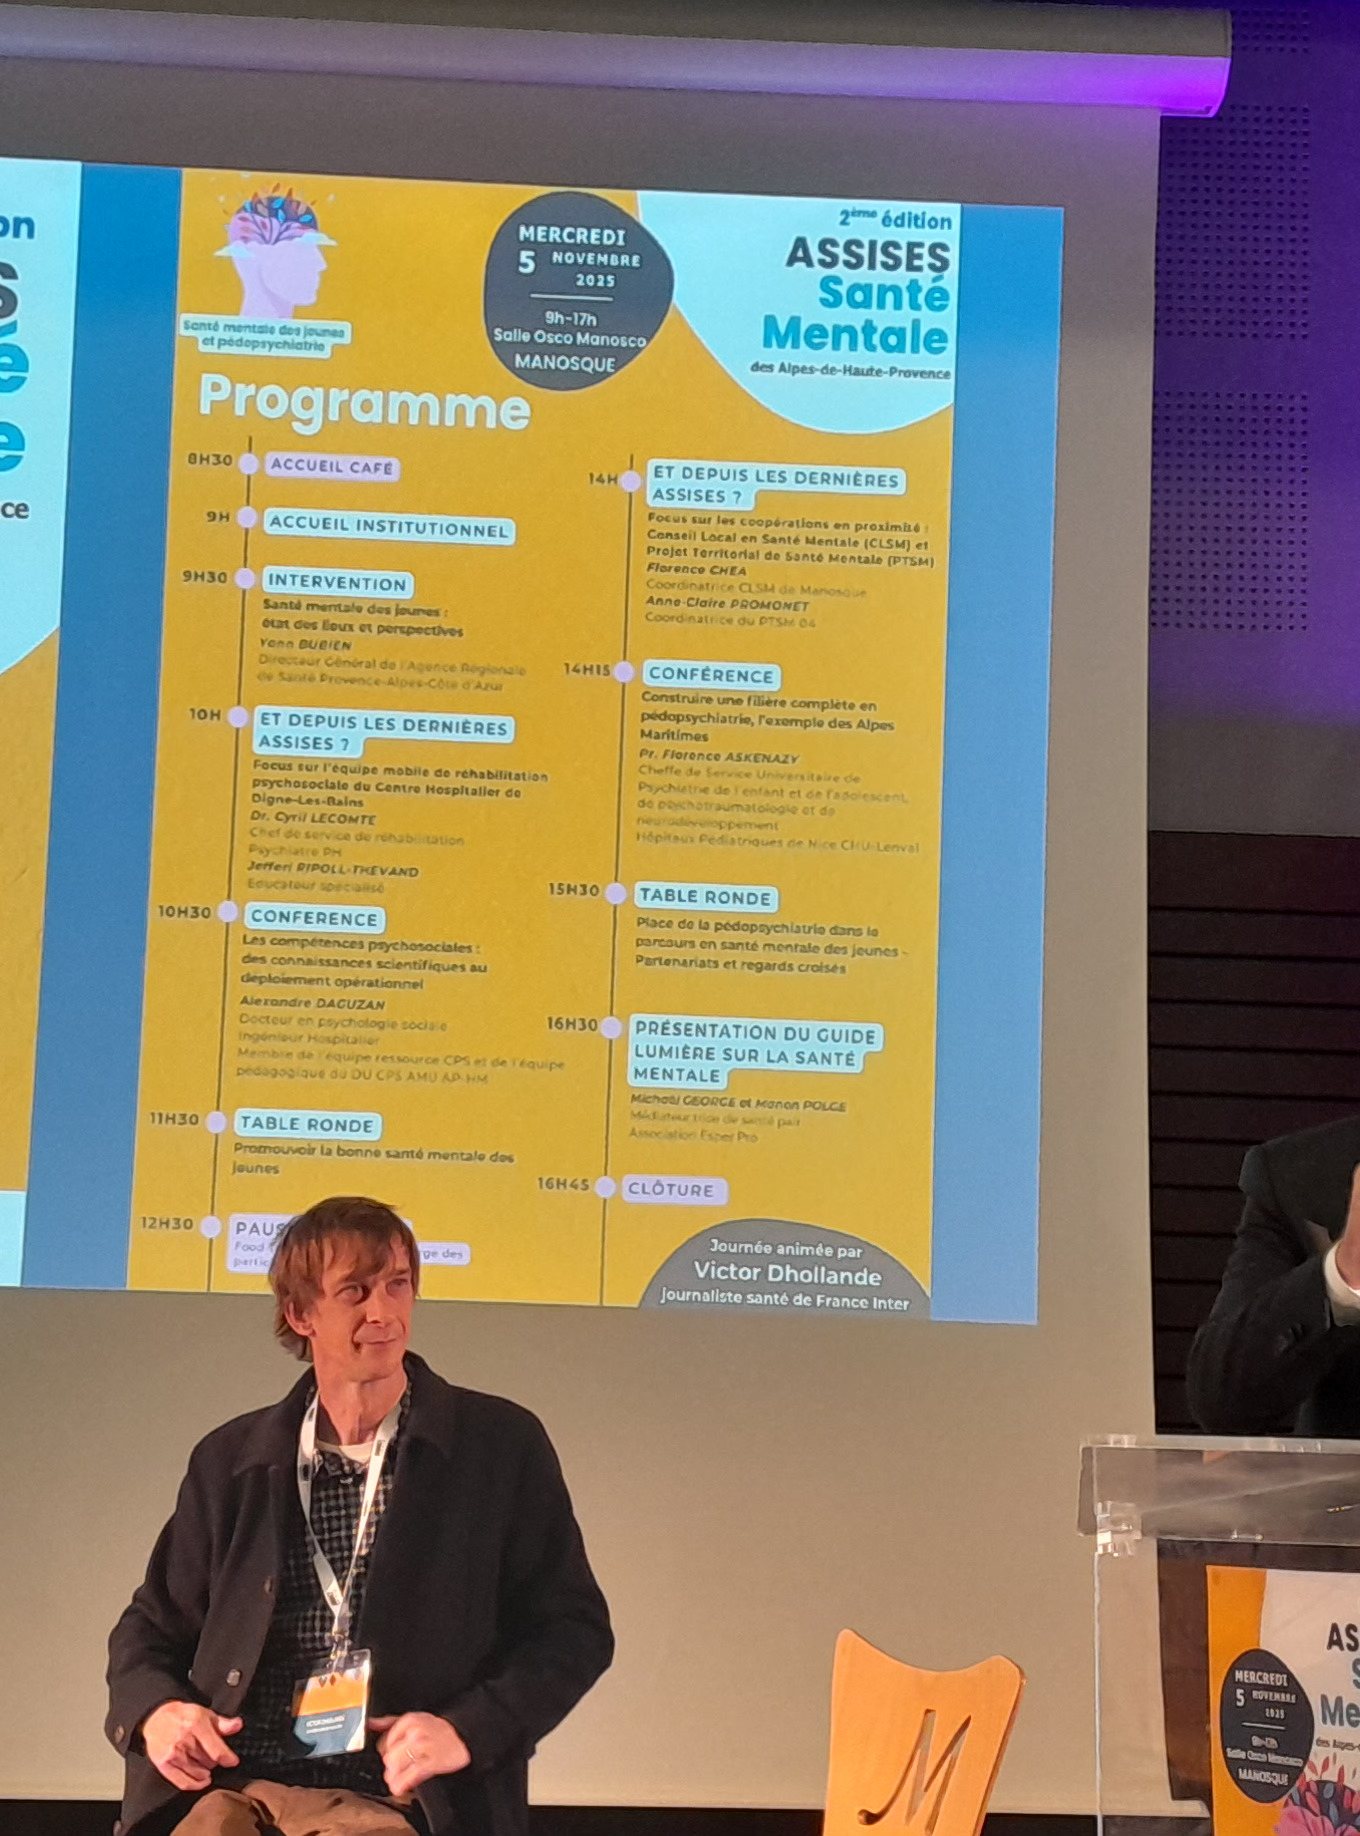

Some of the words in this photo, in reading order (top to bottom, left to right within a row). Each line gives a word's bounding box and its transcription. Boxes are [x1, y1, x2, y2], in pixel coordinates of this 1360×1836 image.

[881, 210, 953, 231] édition
[518, 225, 626, 246] MERCREDI
[518, 251, 536, 273] 5
[552, 251, 641, 267] NOVEMBRE
[785, 236, 951, 273] ASSISES
[576, 272, 615, 288] 2025
[818, 274, 951, 311] Santé
[545, 310, 597, 328] 9h-17h
[494, 327, 531, 344] Salle
[533, 329, 572, 345] Osco
[576, 331, 647, 348] Manosco
[762, 314, 949, 355] Mentale
[514, 353, 616, 373] MANOSQUE
[750, 361, 774, 374] des
[778, 361, 952, 382] Alpes-de-Haute-Provence
[199, 372, 532, 436] Programme
[187, 452, 233, 467] 8H30
[271, 457, 343, 473] ACCUEIL
[350, 459, 393, 476] CAFÉ
[589, 472, 618, 486] 14H
[653, 465, 675, 480] ET
[681, 467, 748, 483] DEPUIS
[755, 469, 787, 484] LES
[793, 469, 899, 489] DERNIÈRES
[652, 488, 725, 503] ASSISES
[732, 491, 742, 505] ?
[206, 511, 230, 523] 9H
[269, 515, 349, 531] ACCUEIL
[356, 519, 509, 538] INSTITUTIONNEL
[182, 570, 228, 584] 9H30
[268, 572, 407, 592] INTERVENTION
[564, 662, 610, 676] 14H15
[649, 665, 774, 684] CONFÉRENCE
[189, 708, 222, 721] 10H
[260, 713, 281, 726] ET
[288, 714, 357, 729] DEPUIS
[364, 716, 396, 730] LES
[403, 716, 508, 736] DERNIÈRES
[259, 735, 334, 751] ASSISES
[340, 738, 349, 751] ?
[549, 883, 600, 897] 15H30
[640, 888, 698, 903] TABLE
[705, 890, 771, 906] RONDE
[159, 905, 212, 919] 10H30
[251, 910, 378, 927] CONFERENCE
[547, 1017, 598, 1032] 16H30
[635, 1020, 777, 1040] PRÉSENTATION
[784, 1027, 811, 1041] DU
[817, 1028, 876, 1045] GUIDE
[635, 1042, 716, 1060] LUMIÈRE
[722, 1047, 759, 1062] SUR
[766, 1050, 789, 1063] LA
[796, 1050, 855, 1066] SANTÉ
[634, 1067, 720, 1083] MENTALE
[149, 1112, 200, 1126] 11H30
[241, 1115, 300, 1131] TABLE
[307, 1117, 373, 1133] RONDE
[234, 1142, 316, 1157] Promouvoir
[320, 1145, 333, 1157] la
[337, 1146, 381, 1158] bonne
[385, 1146, 423, 1160] santé
[428, 1149, 486, 1162] mentale
[489, 1151, 515, 1163] des
[232, 1162, 280, 1176] jeunes
[538, 1177, 590, 1191] 16H45
[628, 1180, 714, 1198] CLÔTURE
[141, 1217, 194, 1230] 12H30
[710, 1238, 772, 1255] Journée
[776, 1241, 834, 1258] animée
[838, 1245, 863, 1260] par
[695, 1261, 761, 1281] Victor
[768, 1263, 882, 1286] Dhollande
[746, 1291, 788, 1306] santé
[793, 1292, 811, 1307] de
[817, 1294, 868, 1309] France
[873, 1296, 911, 1310] Inter
